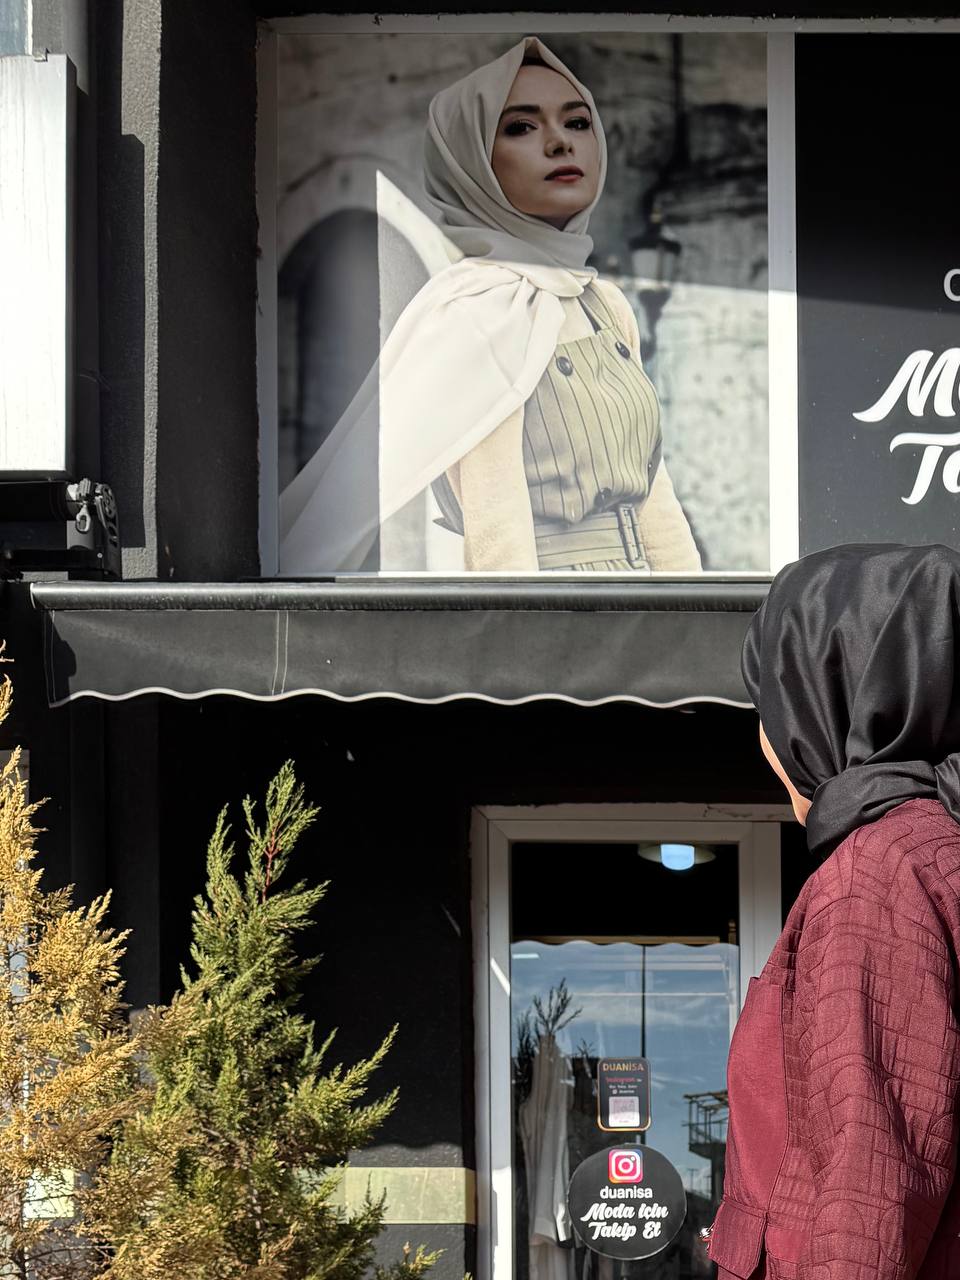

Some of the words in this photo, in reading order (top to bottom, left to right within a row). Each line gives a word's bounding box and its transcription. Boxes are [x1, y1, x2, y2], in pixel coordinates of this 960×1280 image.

[600, 1185, 653, 1200] duanisa
[580, 1202, 636, 1222] Moda
[638, 1202, 669, 1221] için
[588, 1221, 638, 1242] Takip
[642, 1220, 662, 1240] Et
